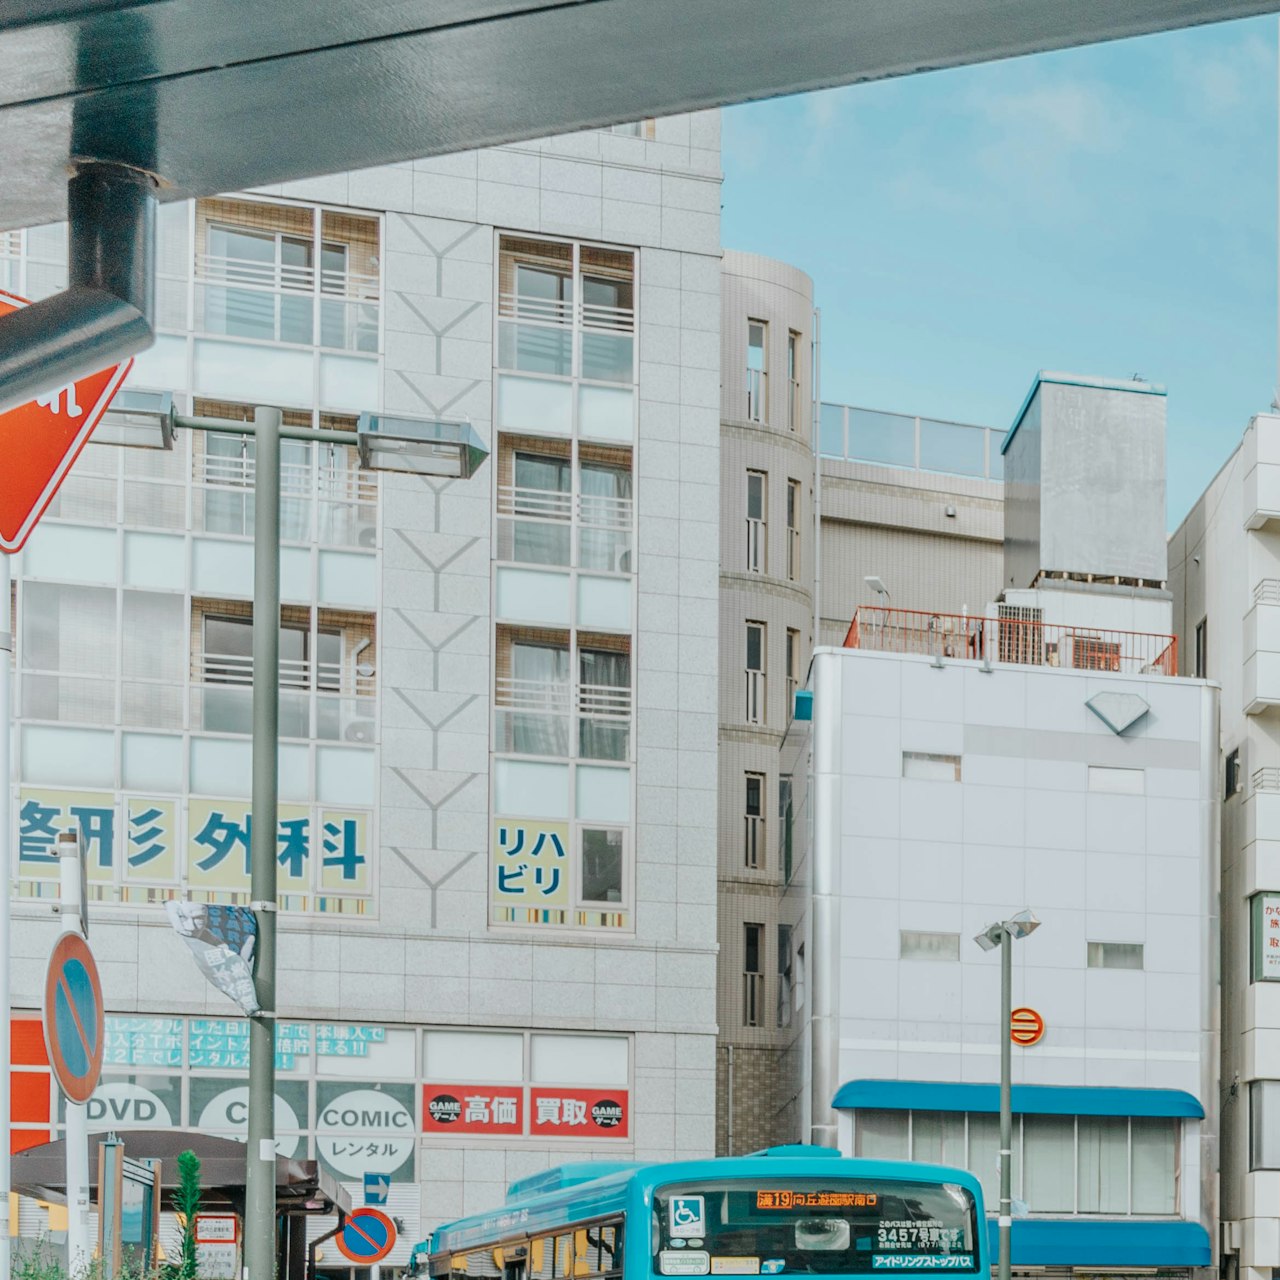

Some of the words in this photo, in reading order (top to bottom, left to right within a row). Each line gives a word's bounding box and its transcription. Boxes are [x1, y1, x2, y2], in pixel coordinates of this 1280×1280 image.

[500, 827, 565, 860] リハ
[498, 863, 562, 896] ビリ
[87, 1098, 157, 1121] DVD
[429, 1102, 461, 1111] GAME
[464, 1095, 517, 1124] 高価
[536, 1098, 588, 1126] 買取
[592, 1107, 623, 1116] GAME
[323, 1108, 408, 1128] COMIC
[433, 1112, 458, 1121] ゲーム
[596, 1117, 619, 1126] ゲーム
[332, 1140, 398, 1157] レンタル
[878, 1228, 959, 1242] 3457号車です
[875, 1256, 972, 1268] アイドリングストップバス
